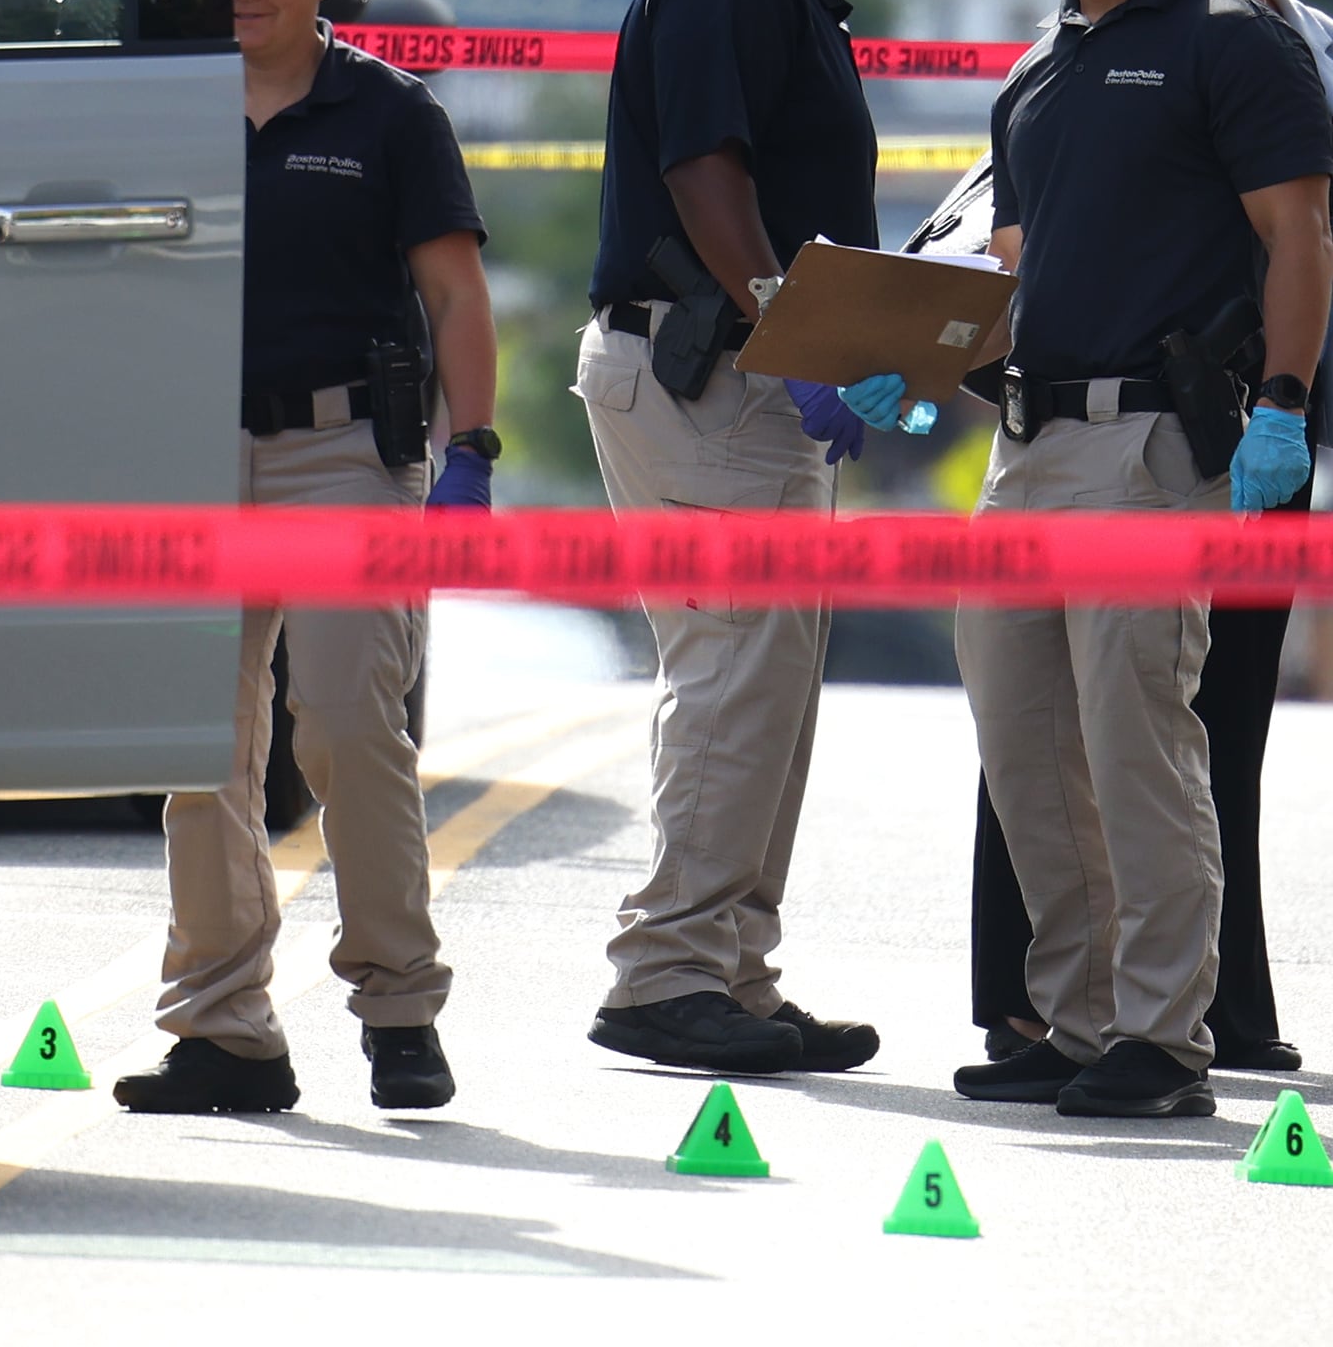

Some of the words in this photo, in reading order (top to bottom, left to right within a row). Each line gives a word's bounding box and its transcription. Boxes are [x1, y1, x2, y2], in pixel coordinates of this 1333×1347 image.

[376, 33, 455, 64] SCENE
[463, 35, 545, 66] CRIME
[898, 47, 980, 76] CRIME
[287, 153, 327, 164] Boston
[328, 155, 363, 171] Police
[39, 1026, 57, 1060] 3
[714, 1111, 732, 1147] 4
[1286, 1121, 1304, 1157] 6
[924, 1173, 942, 1209] 5
